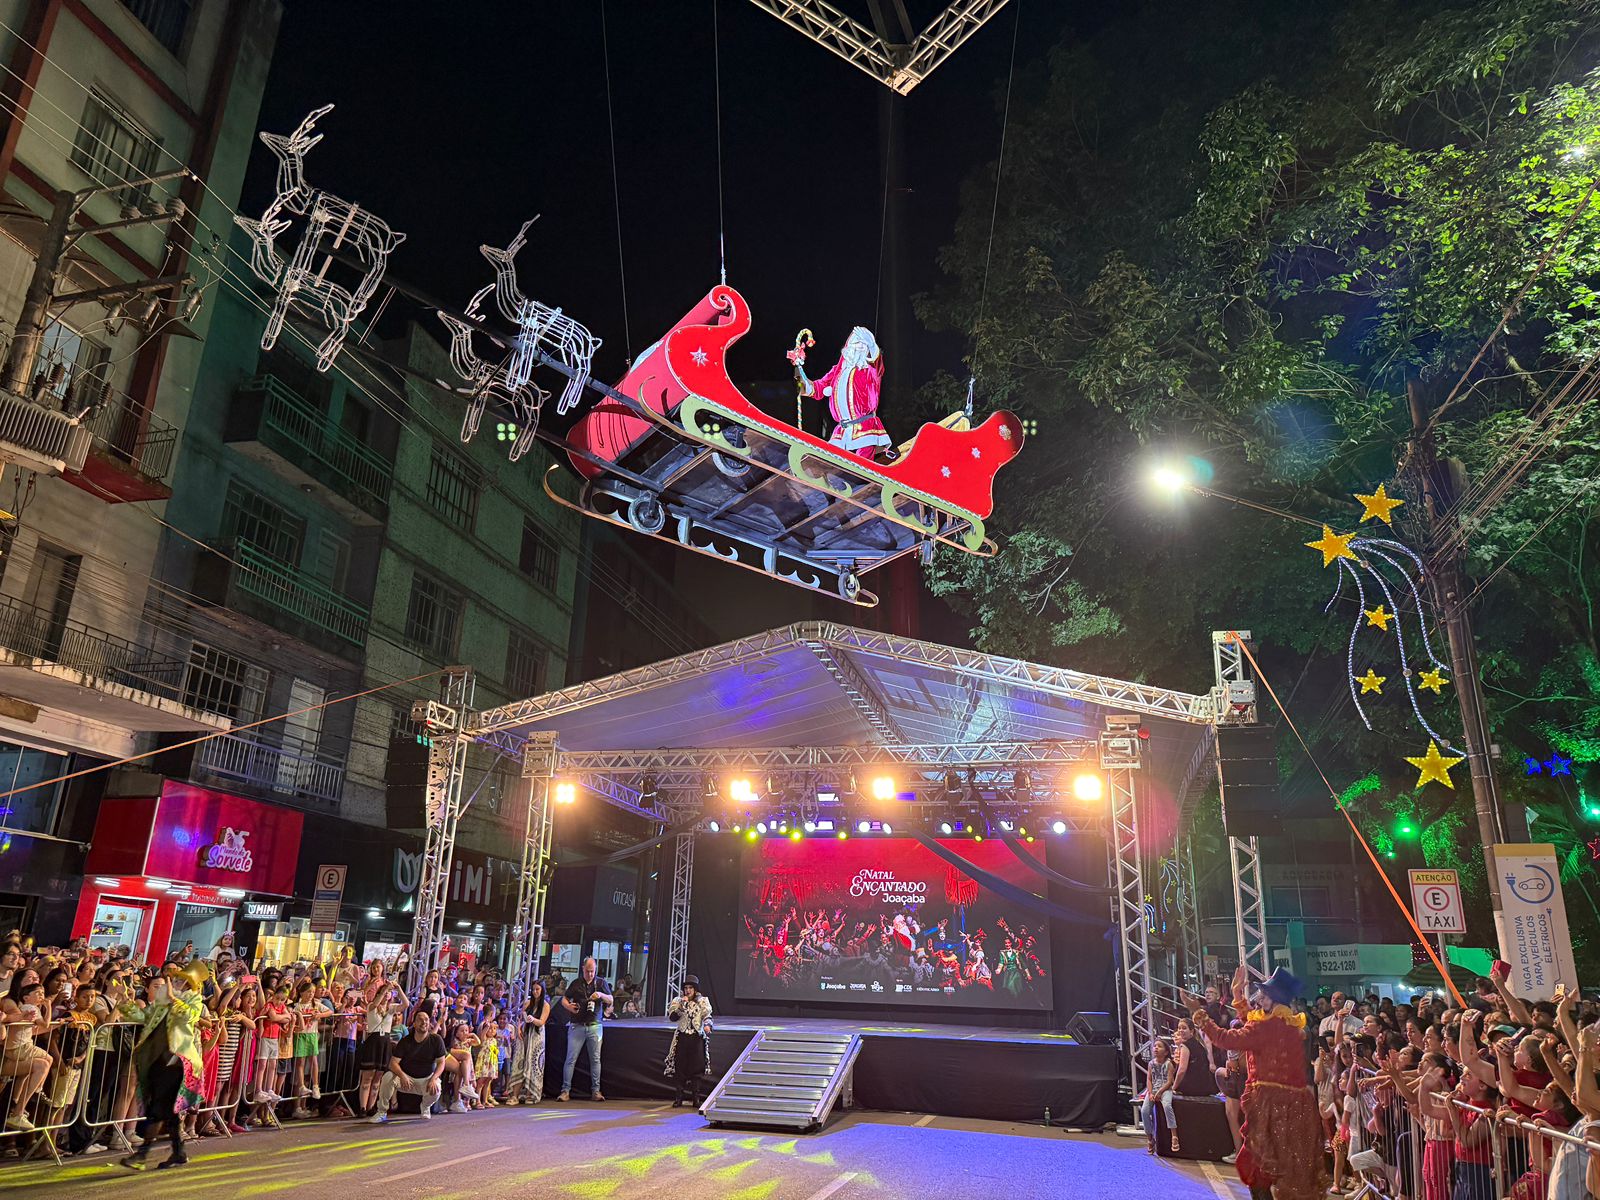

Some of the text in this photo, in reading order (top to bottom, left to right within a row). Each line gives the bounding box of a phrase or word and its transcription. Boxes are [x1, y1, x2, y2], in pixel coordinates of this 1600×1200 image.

[207, 845, 252, 871] Sorvete
[327, 873, 335, 885] E
[1415, 873, 1452, 882] ATENÇÃO
[882, 893, 926, 905] Joaçaba
[1431, 892, 1442, 906] E
[1424, 912, 1456, 928] TÁXI
[1538, 914, 1553, 963] ELÉTRICOS
[1514, 915, 1533, 991] VAGA EXCLUSIVA
[1526, 915, 1545, 986] PARA VEÍCULOS
